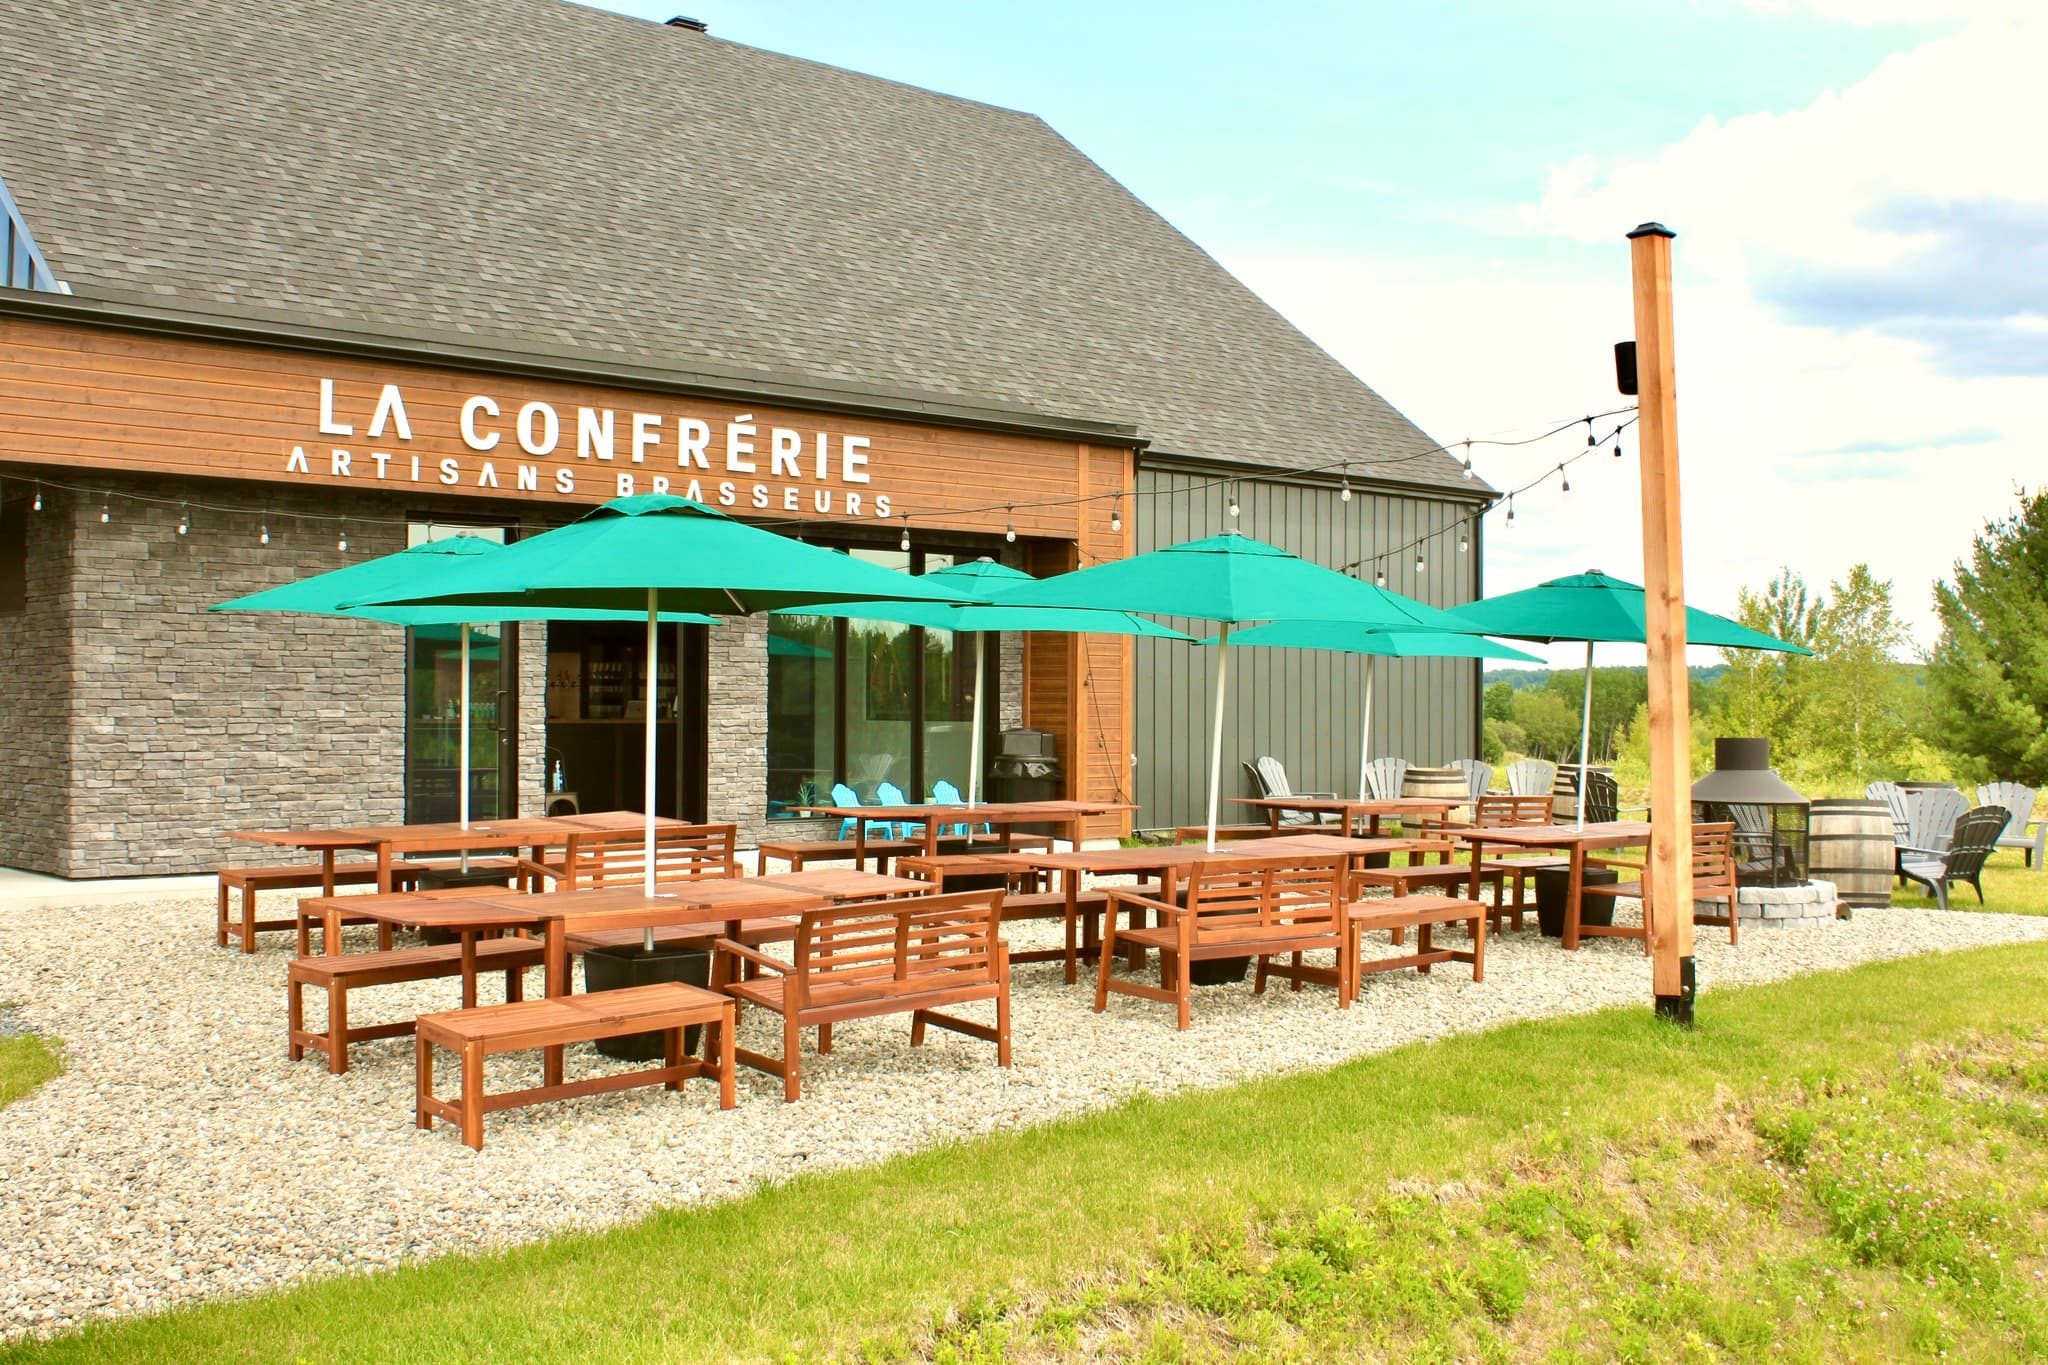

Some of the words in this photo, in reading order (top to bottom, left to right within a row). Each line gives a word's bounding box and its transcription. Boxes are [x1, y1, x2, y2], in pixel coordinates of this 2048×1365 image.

[319, 378, 413, 440] LA
[460, 396, 871, 484] CONFRÉRIE
[285, 446, 575, 494] ARTISANS
[616, 473, 891, 518] BRASSEURS
